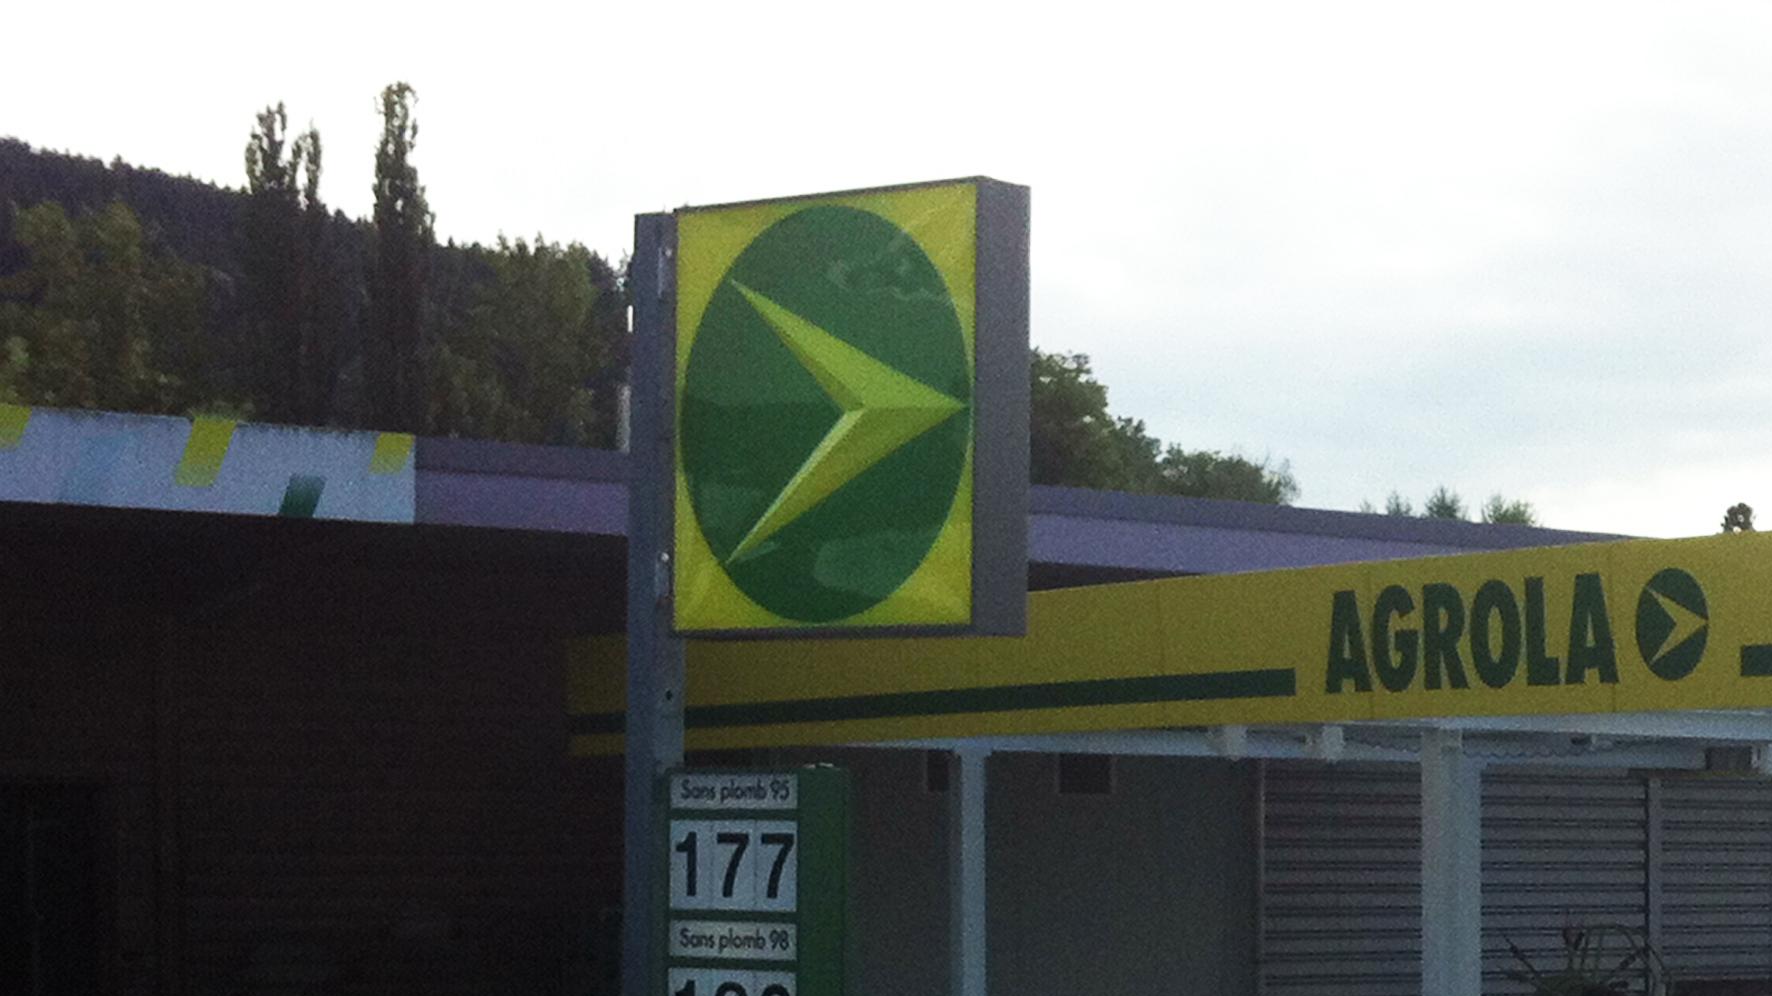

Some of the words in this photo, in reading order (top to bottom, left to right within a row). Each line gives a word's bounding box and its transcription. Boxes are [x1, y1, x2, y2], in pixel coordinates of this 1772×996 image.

[1325, 573, 1620, 694] AGROLA
[681, 779, 717, 799] Sans
[719, 779, 766, 804] plomb
[768, 781, 791, 799] 95
[674, 832, 796, 898] 177
[679, 928, 715, 950] Sans
[718, 928, 766, 954] plomb
[768, 930, 790, 950] 98
